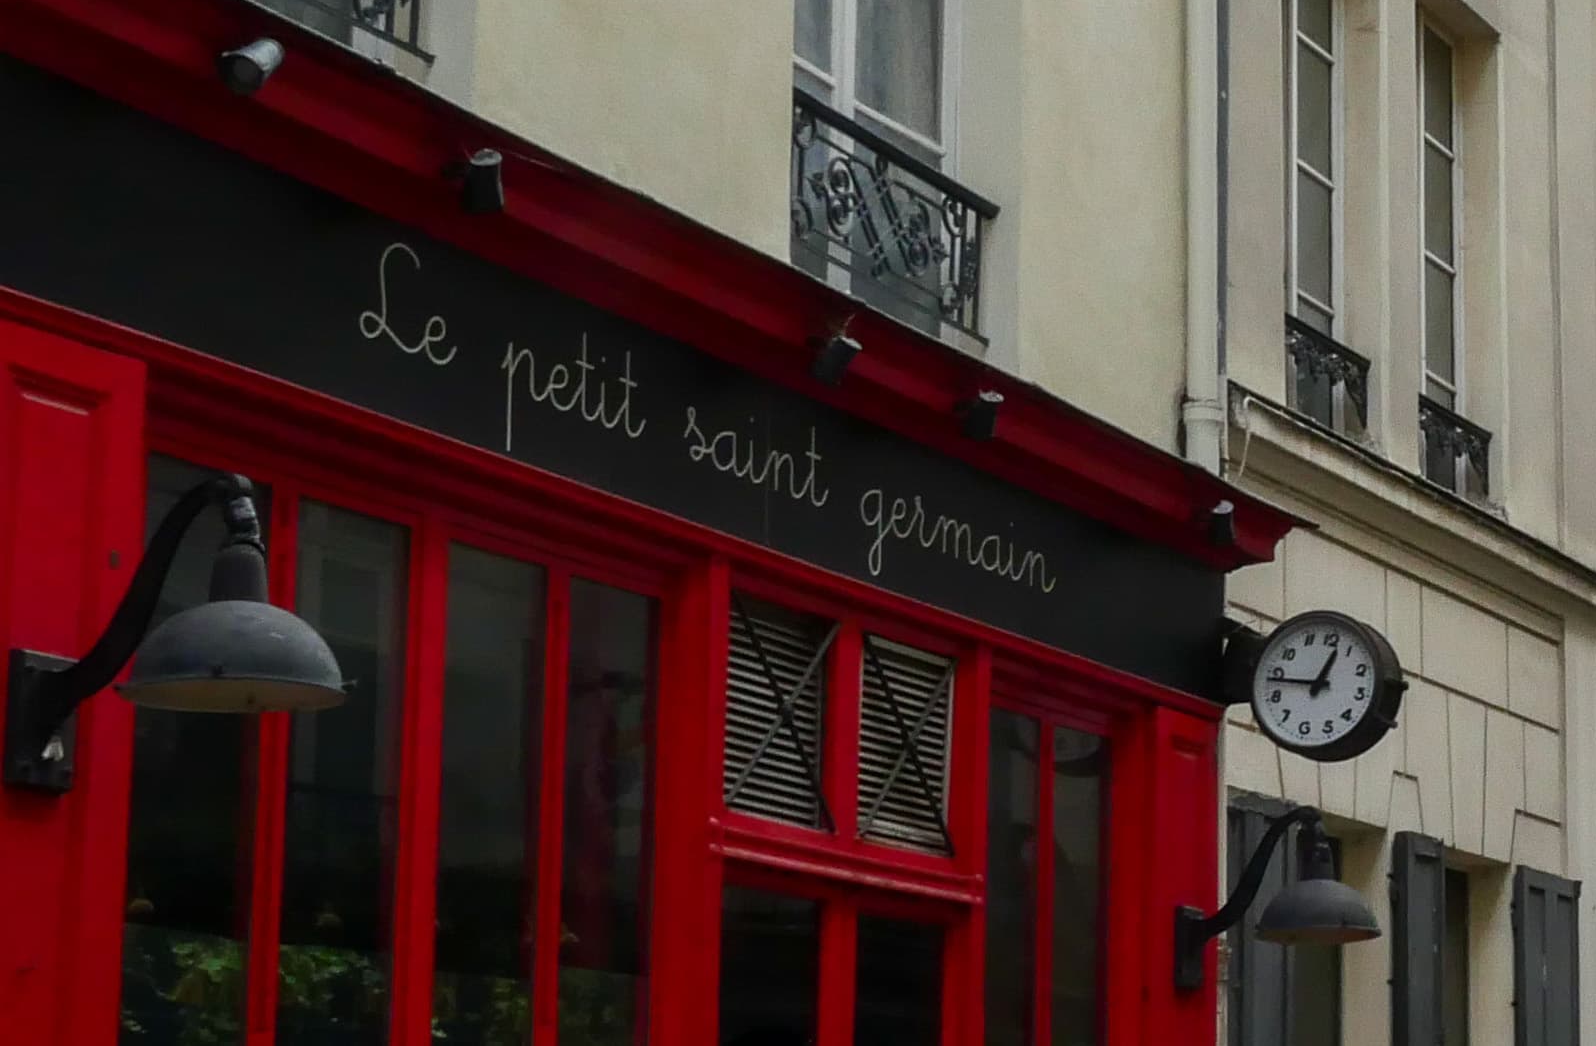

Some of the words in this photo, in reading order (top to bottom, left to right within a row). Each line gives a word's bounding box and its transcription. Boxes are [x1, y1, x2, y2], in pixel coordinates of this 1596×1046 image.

[360, 242, 457, 365] Le
[501, 331, 646, 452] petit
[684, 406, 829, 507] saint
[860, 489, 1056, 592] germain
[1304, 633, 1315, 646] 11
[1323, 633, 1339, 647] 12
[1282, 648, 1296, 661] 10
[1345, 645, 1352, 657] 1
[1355, 664, 1367, 677] 2
[1271, 690, 1281, 703] 8
[1354, 687, 1365, 701] 3
[1281, 709, 1291, 723] 7
[1340, 708, 1352, 721] 4
[1298, 721, 1311, 735] 6
[1322, 720, 1333, 734] 5
